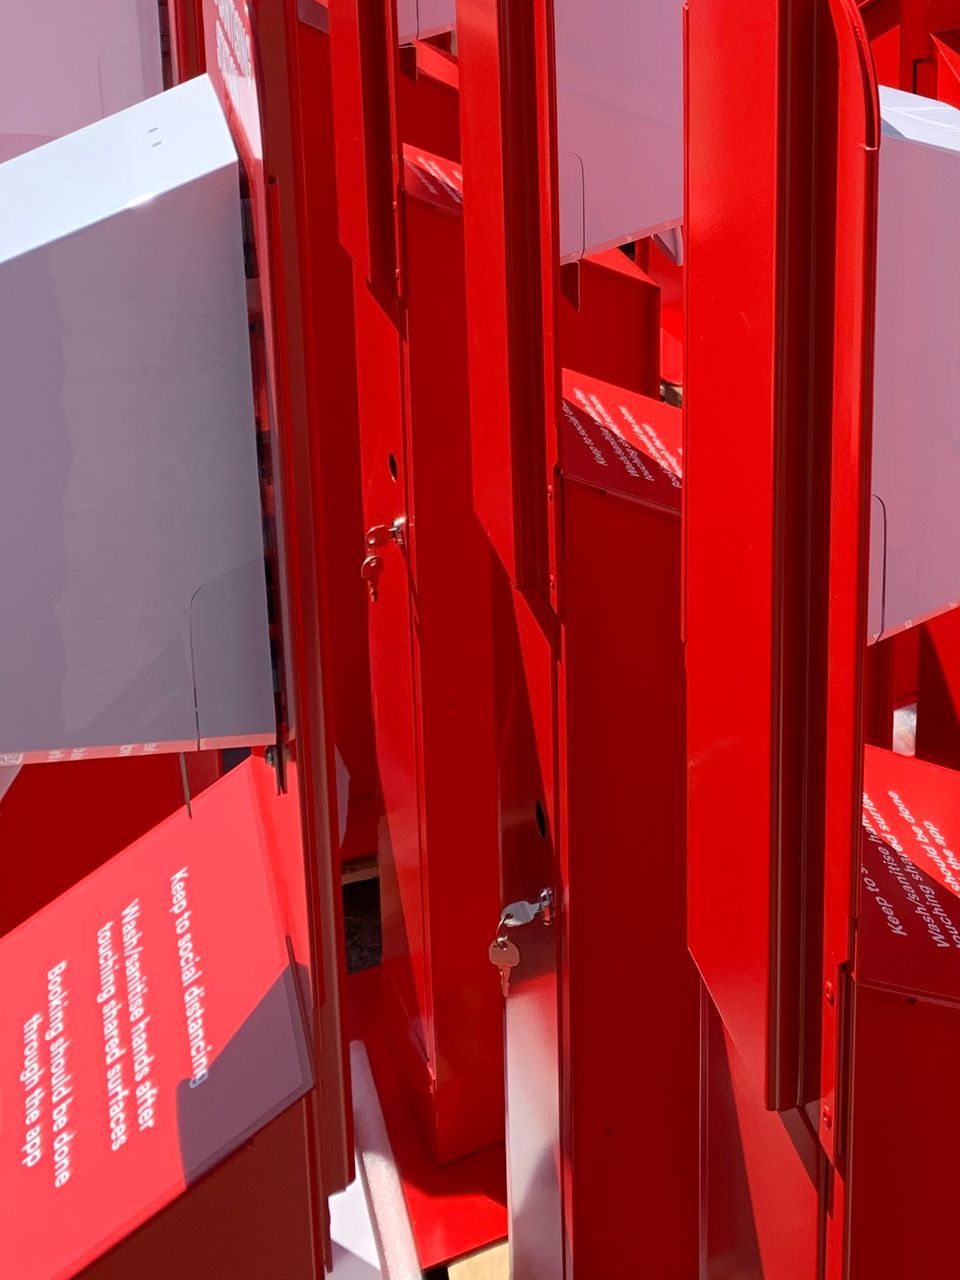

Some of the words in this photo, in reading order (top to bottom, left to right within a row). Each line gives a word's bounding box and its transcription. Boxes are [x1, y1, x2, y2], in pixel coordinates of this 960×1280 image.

[887, 790, 916, 824] done
[922, 820, 947, 847] app
[880, 832, 923, 882] shared
[911, 825, 930, 844] be
[169, 866, 189, 914] Keep
[863, 877, 880, 893] to
[877, 846, 950, 948] Wash/sanitise
[175, 911, 192, 935] to
[875, 895, 908, 937] Keep
[96, 920, 119, 1004] touching
[121, 898, 149, 1023] Wash/sanitise
[178, 933, 202, 988] social
[45, 960, 69, 1041] Booking
[19, 1011, 46, 1092] through
[102, 999, 126, 1066] shared
[131, 1015, 154, 1082] hands
[184, 986, 213, 1089] distancing
[50, 1036, 73, 1105] should
[25, 1086, 46, 1126] the
[52, 1096, 75, 1133] be
[106, 1063, 129, 1152] surfaces
[136, 1080, 158, 1132] after
[21, 1124, 43, 1168] app
[53, 1130, 77, 1188] done
